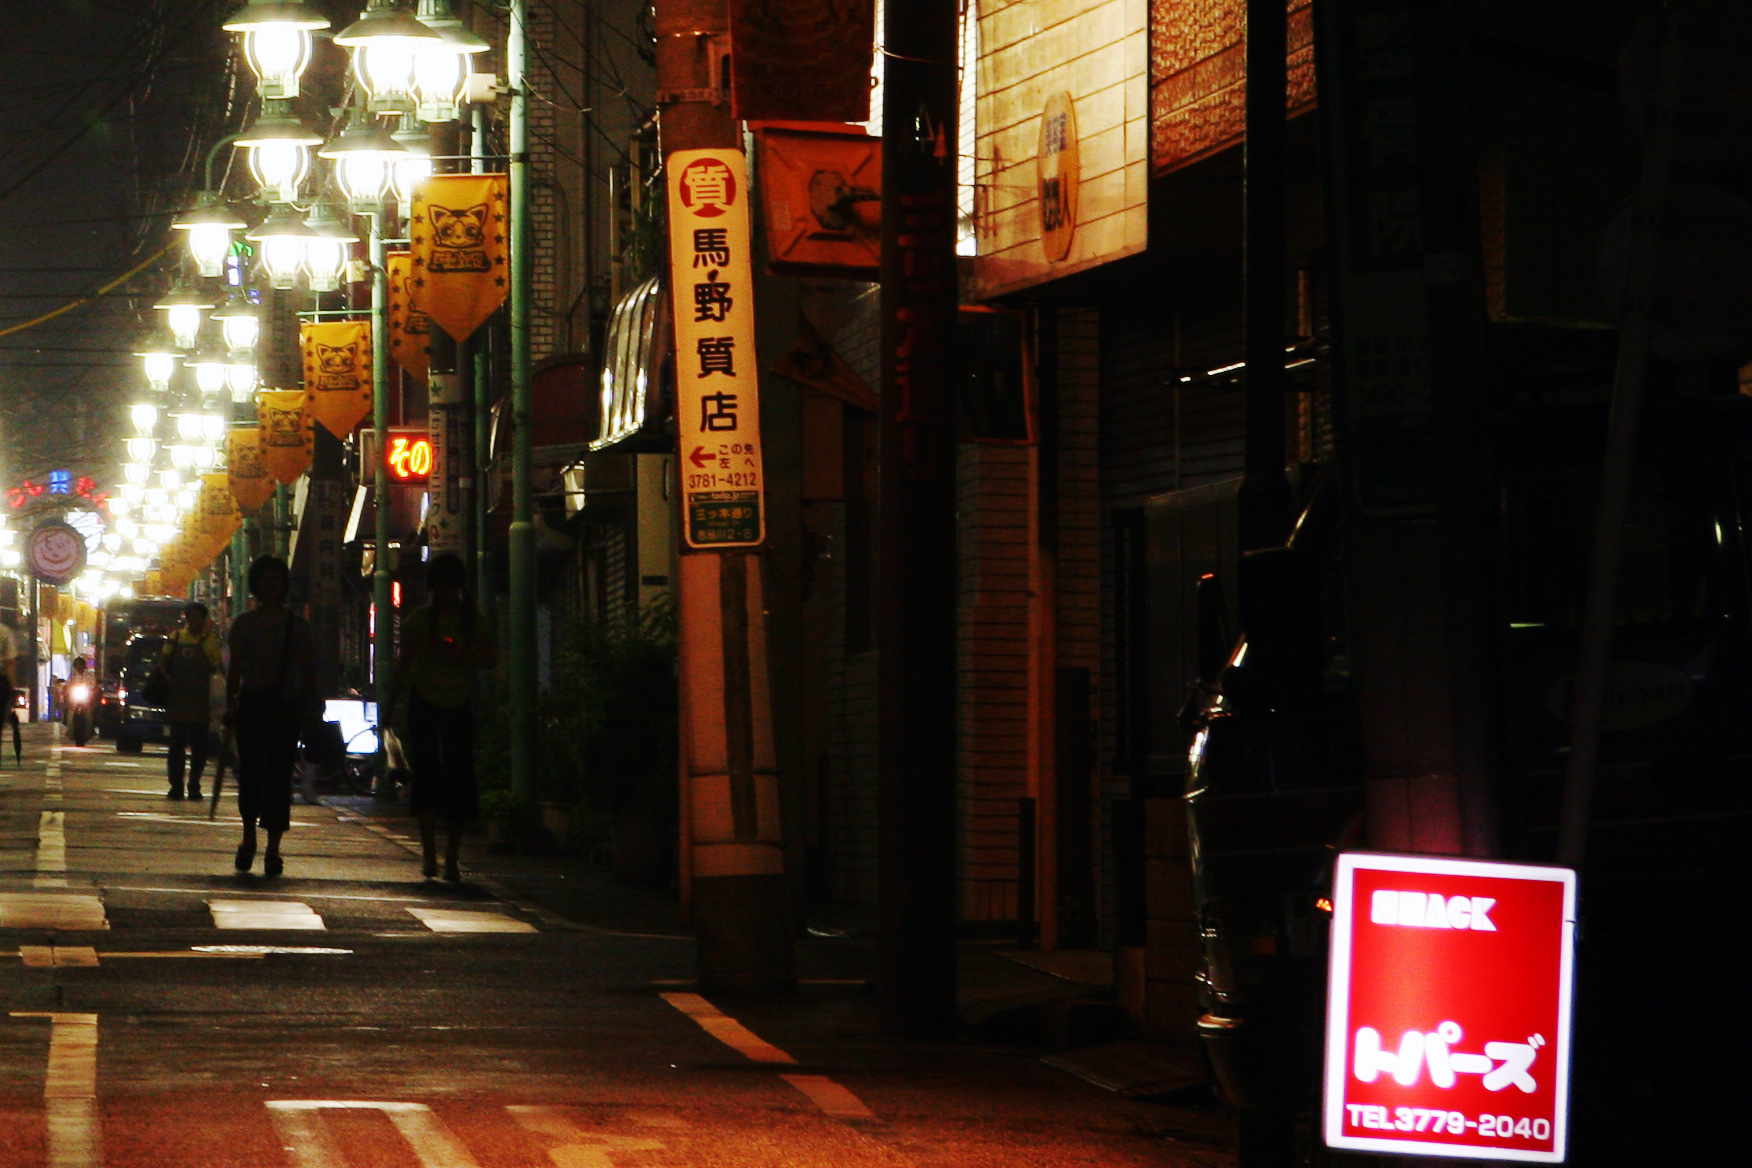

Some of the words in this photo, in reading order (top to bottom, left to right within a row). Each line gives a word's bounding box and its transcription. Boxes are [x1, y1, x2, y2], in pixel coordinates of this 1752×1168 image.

[684, 163, 732, 213] 質
[689, 472, 757, 489] 3781-4212
[1371, 890, 1498, 932] SNACK
[1353, 1019, 1546, 1094] トパーズ
[1345, 1102, 1551, 1141] TEL3779-2040
